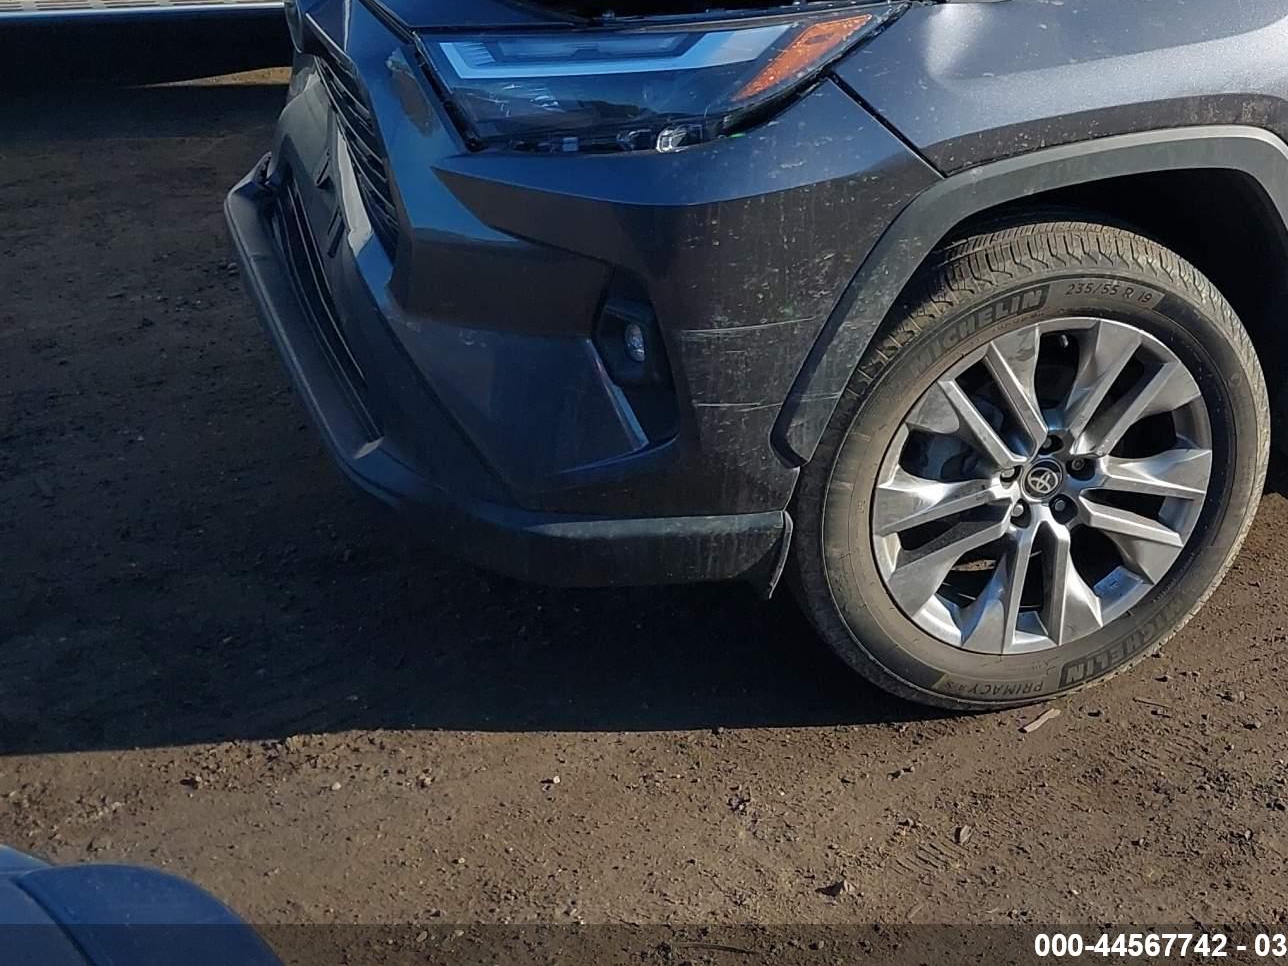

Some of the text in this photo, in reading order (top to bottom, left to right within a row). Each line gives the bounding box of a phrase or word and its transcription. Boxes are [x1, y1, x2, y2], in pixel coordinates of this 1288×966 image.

[1065, 284, 1118, 297] 235/55
[910, 289, 1043, 375] MICHELIN
[968, 681, 1044, 697] PRIMACY
